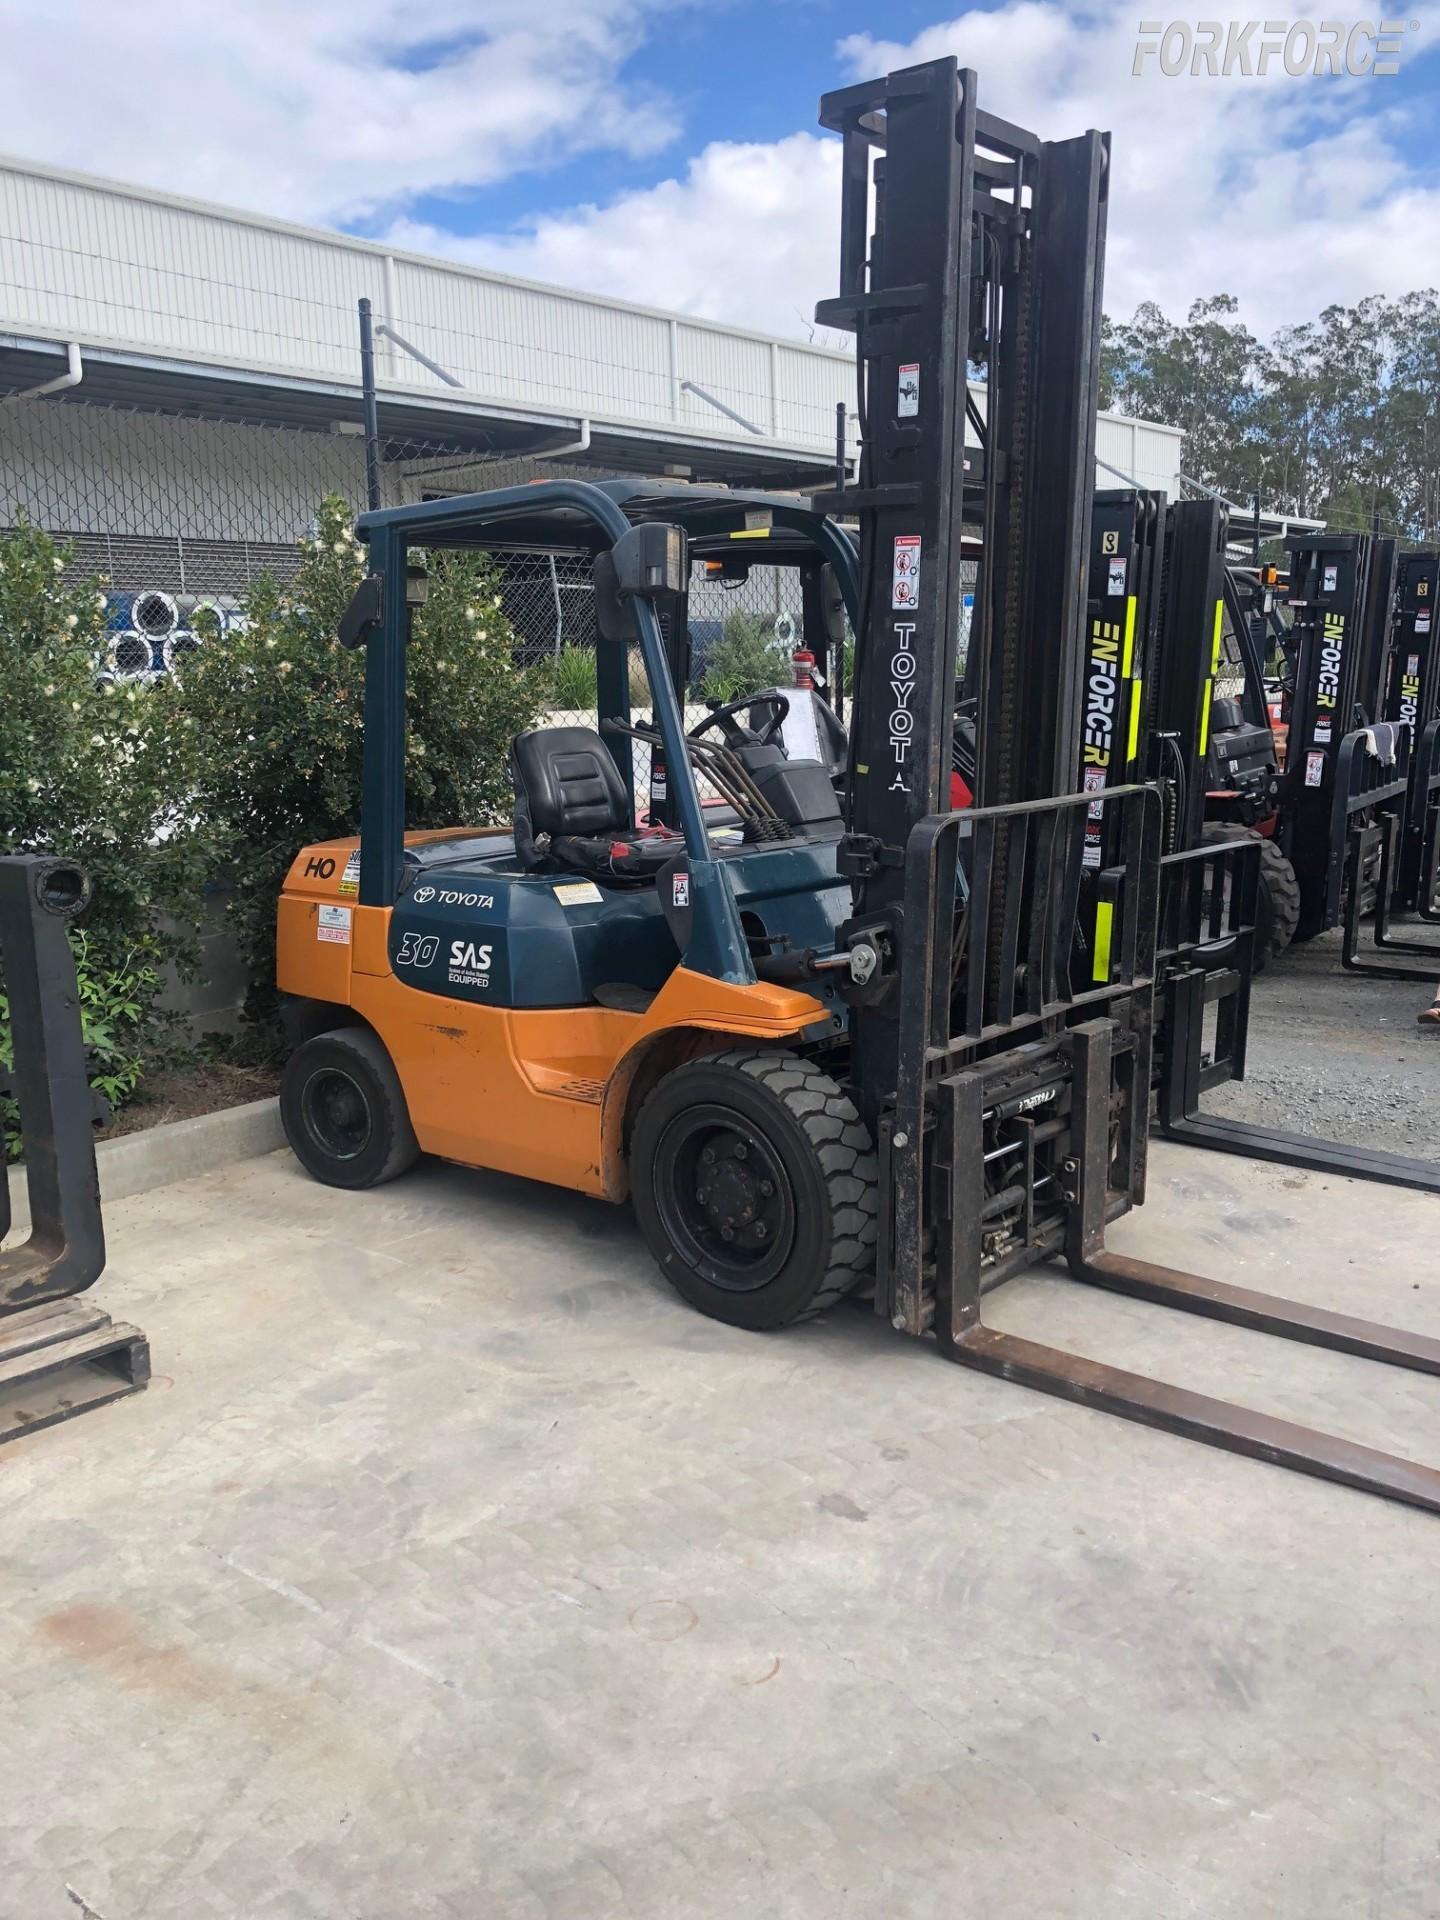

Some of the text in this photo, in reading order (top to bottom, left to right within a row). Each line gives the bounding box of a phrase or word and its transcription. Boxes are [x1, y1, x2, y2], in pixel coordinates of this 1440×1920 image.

[1316, 612, 1345, 708] ENFORCER
[888, 622, 916, 792] TOYOTA
[1083, 620, 1120, 767] ENFORCER
[304, 856, 336, 879] HO
[438, 890, 494, 909] TOYOTA
[396, 932, 440, 968] 30
[449, 940, 493, 970] SAS
[448, 973, 489, 988] EQUIPPED
